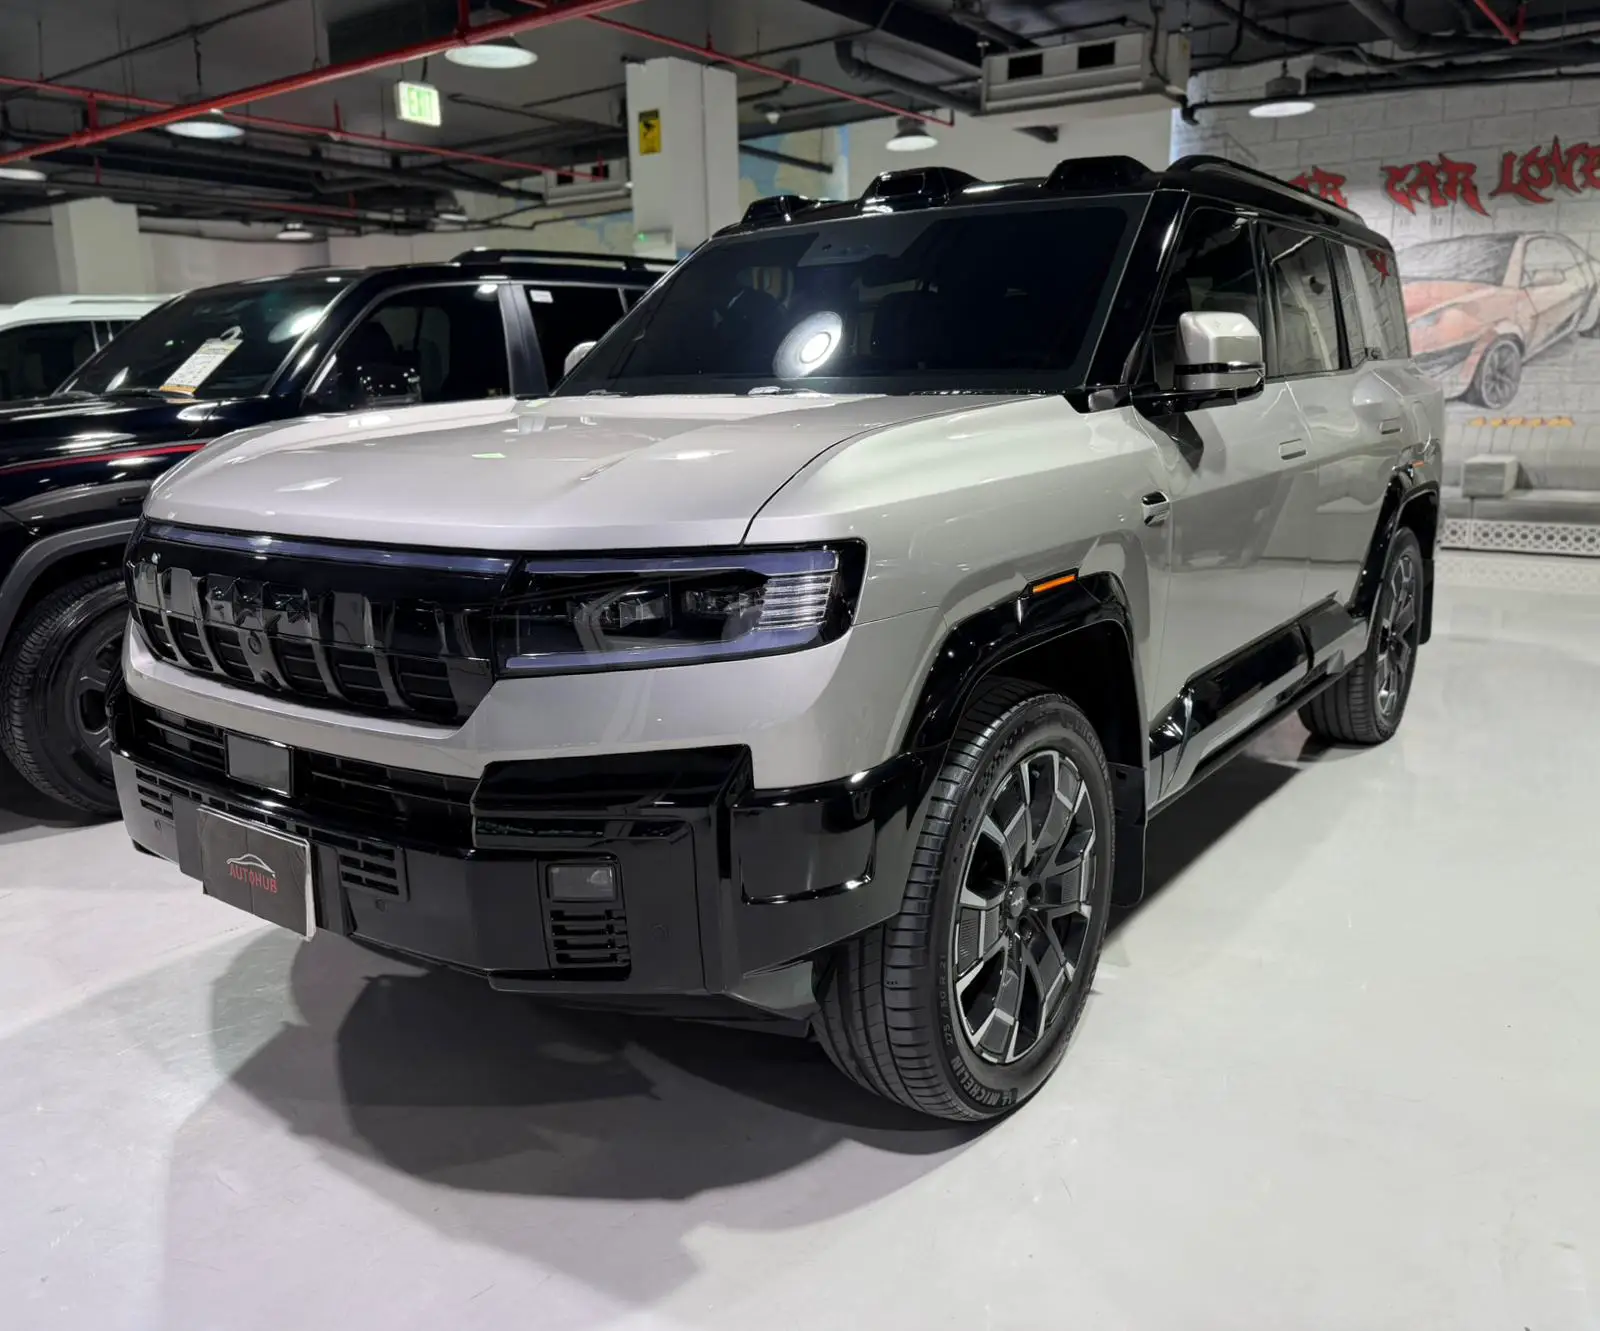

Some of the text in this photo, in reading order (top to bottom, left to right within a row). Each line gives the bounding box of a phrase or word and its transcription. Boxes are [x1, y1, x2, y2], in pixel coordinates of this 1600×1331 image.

[1379, 152, 1490, 217] CAR
[230, 864, 278, 894] AUTOHUB
[950, 1055, 1000, 1106] MICHELIN
